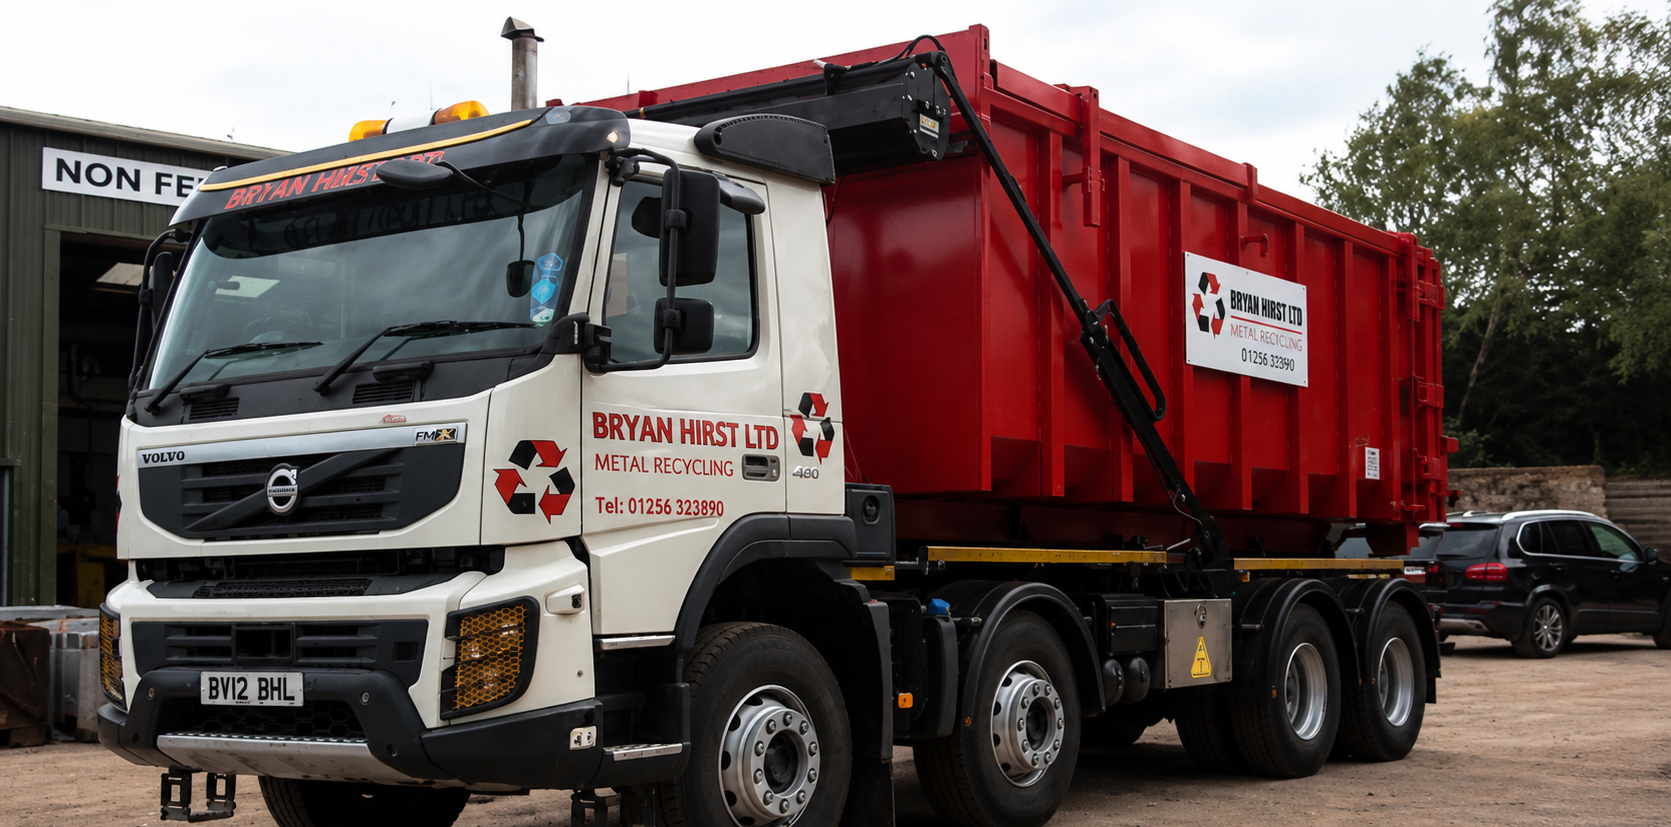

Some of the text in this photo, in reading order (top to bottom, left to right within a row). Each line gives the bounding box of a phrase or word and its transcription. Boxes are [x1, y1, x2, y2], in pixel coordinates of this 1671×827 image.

[56, 157, 206, 198] NON FE
[224, 174, 312, 209] BRYAN
[1230, 289, 1303, 327] BRYAN HIRST LTD
[1230, 323, 1303, 352] METAL RECYCLING
[1241, 347, 1268, 366] 01256
[592, 411, 779, 450] BRYAN HIRST LTD
[142, 450, 185, 464] VOLVO
[595, 453, 734, 477] METAL RECYCLING
[595, 496, 724, 517] Tel: 01256 323890
[208, 677, 295, 701] BV12 BHL
